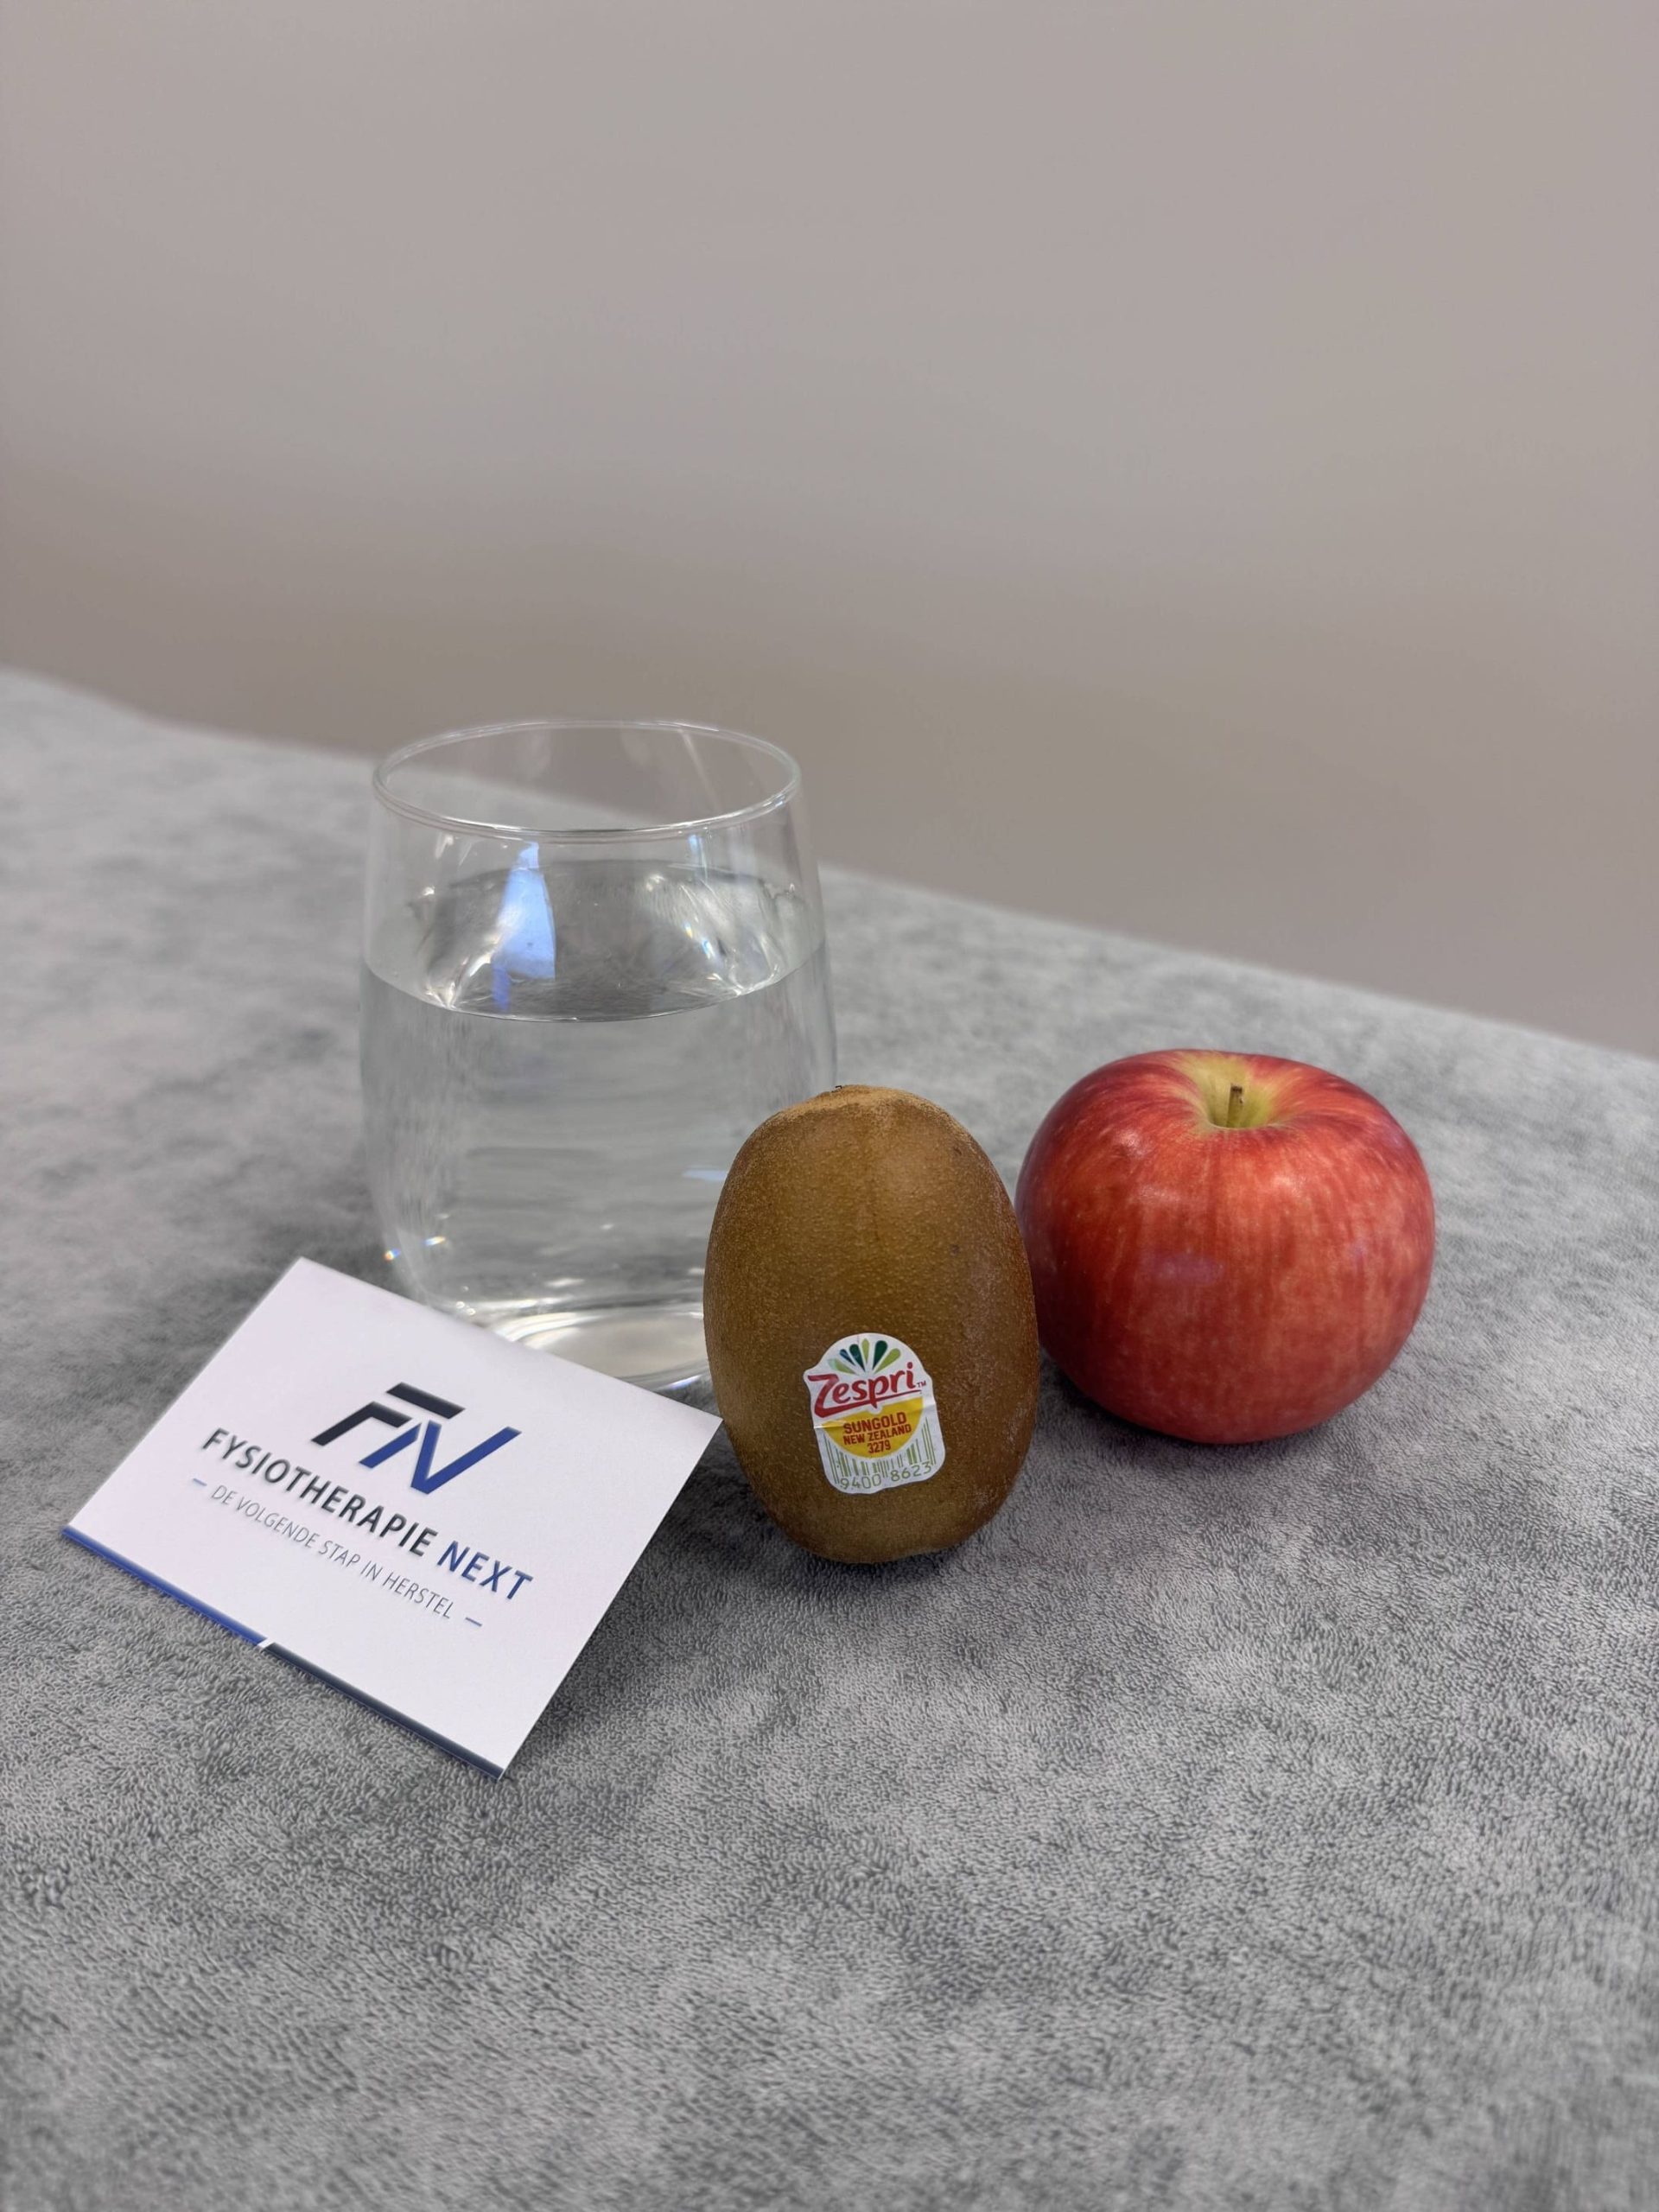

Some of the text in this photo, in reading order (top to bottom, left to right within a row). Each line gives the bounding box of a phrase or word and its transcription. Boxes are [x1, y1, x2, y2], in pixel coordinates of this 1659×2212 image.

[807, 1362, 921, 1418] Zespri
[842, 1424, 912, 1445] NEW ZEALAND
[843, 1412, 906, 1433] SUNGOLD
[868, 1440, 891, 1453] 3279
[840, 1461, 931, 1489] 9400 8623
[202, 1427, 533, 1599] FYSIOTHERAPIE NEXT
[211, 1484, 454, 1619] DE VOLGENDE STAP IN HERSTEL
